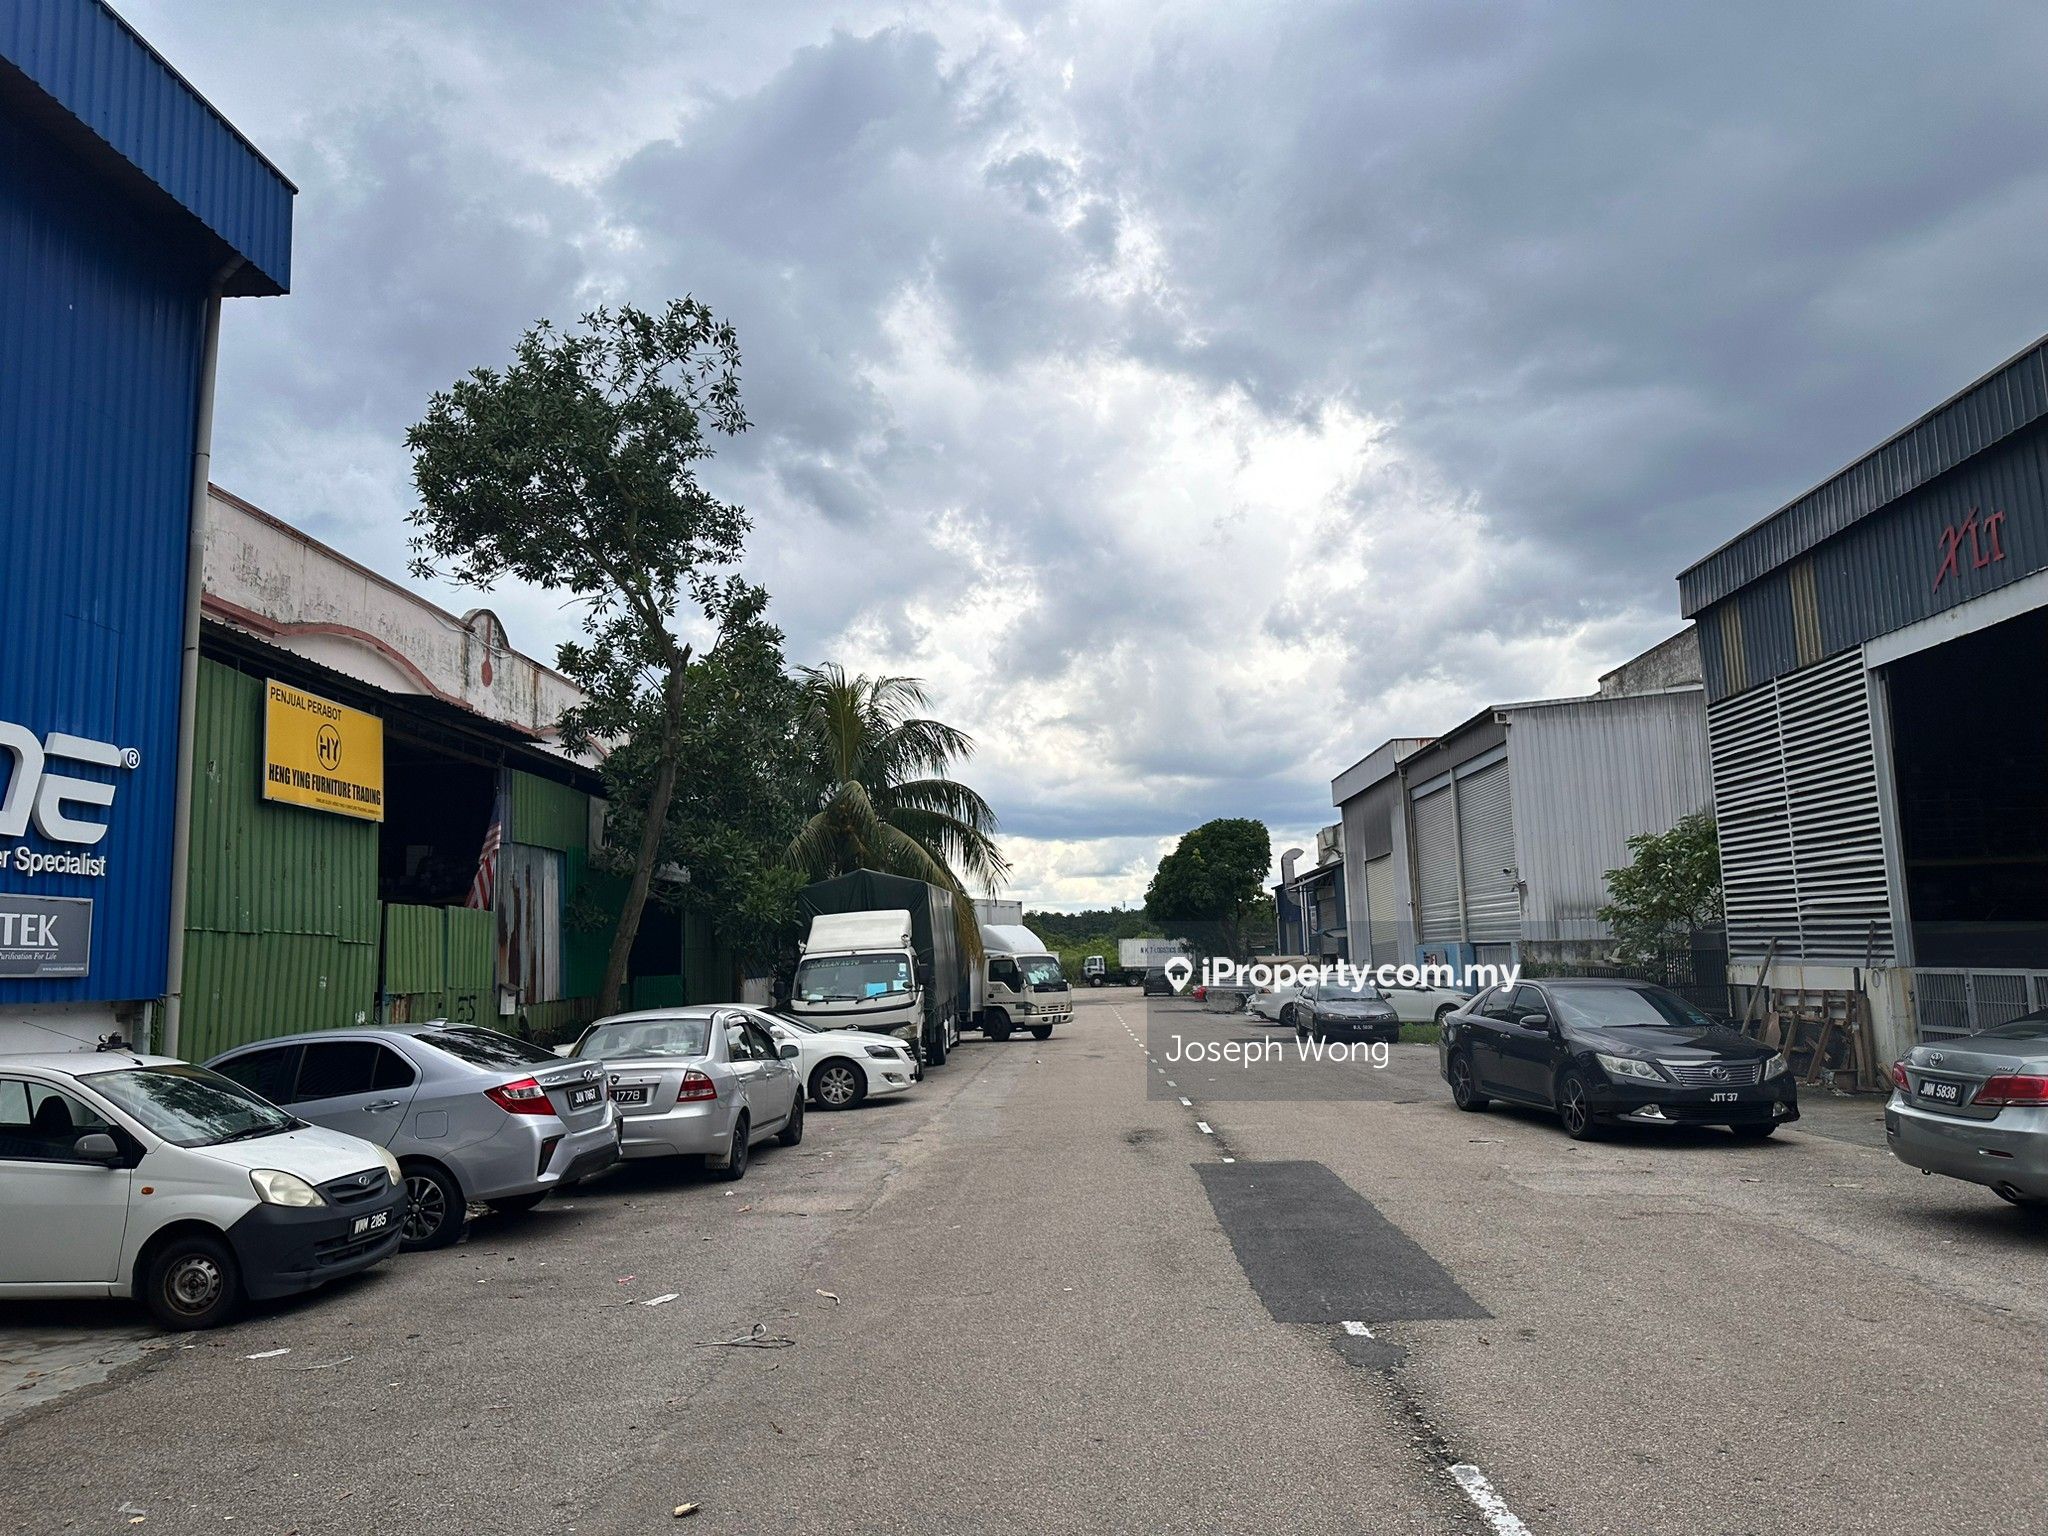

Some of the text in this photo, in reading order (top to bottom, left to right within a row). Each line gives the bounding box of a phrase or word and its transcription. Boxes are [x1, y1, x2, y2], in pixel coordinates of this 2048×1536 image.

[1933, 506, 2005, 594] XLT
[270, 686, 342, 721] PENJUAL PERABOT
[268, 763, 381, 805] HENG YING FURNITURE TRADING
[0, 846, 106, 877] r Specialist
[0, 913, 59, 946] TEK
[33, 952, 44, 960] For
[45, 952, 57, 960] Life
[616, 1090, 640, 1101] 1778
[1710, 1093, 1738, 1102] JTT 37
[1935, 1084, 1957, 1100] 5838
[370, 1211, 387, 1229] 2185
